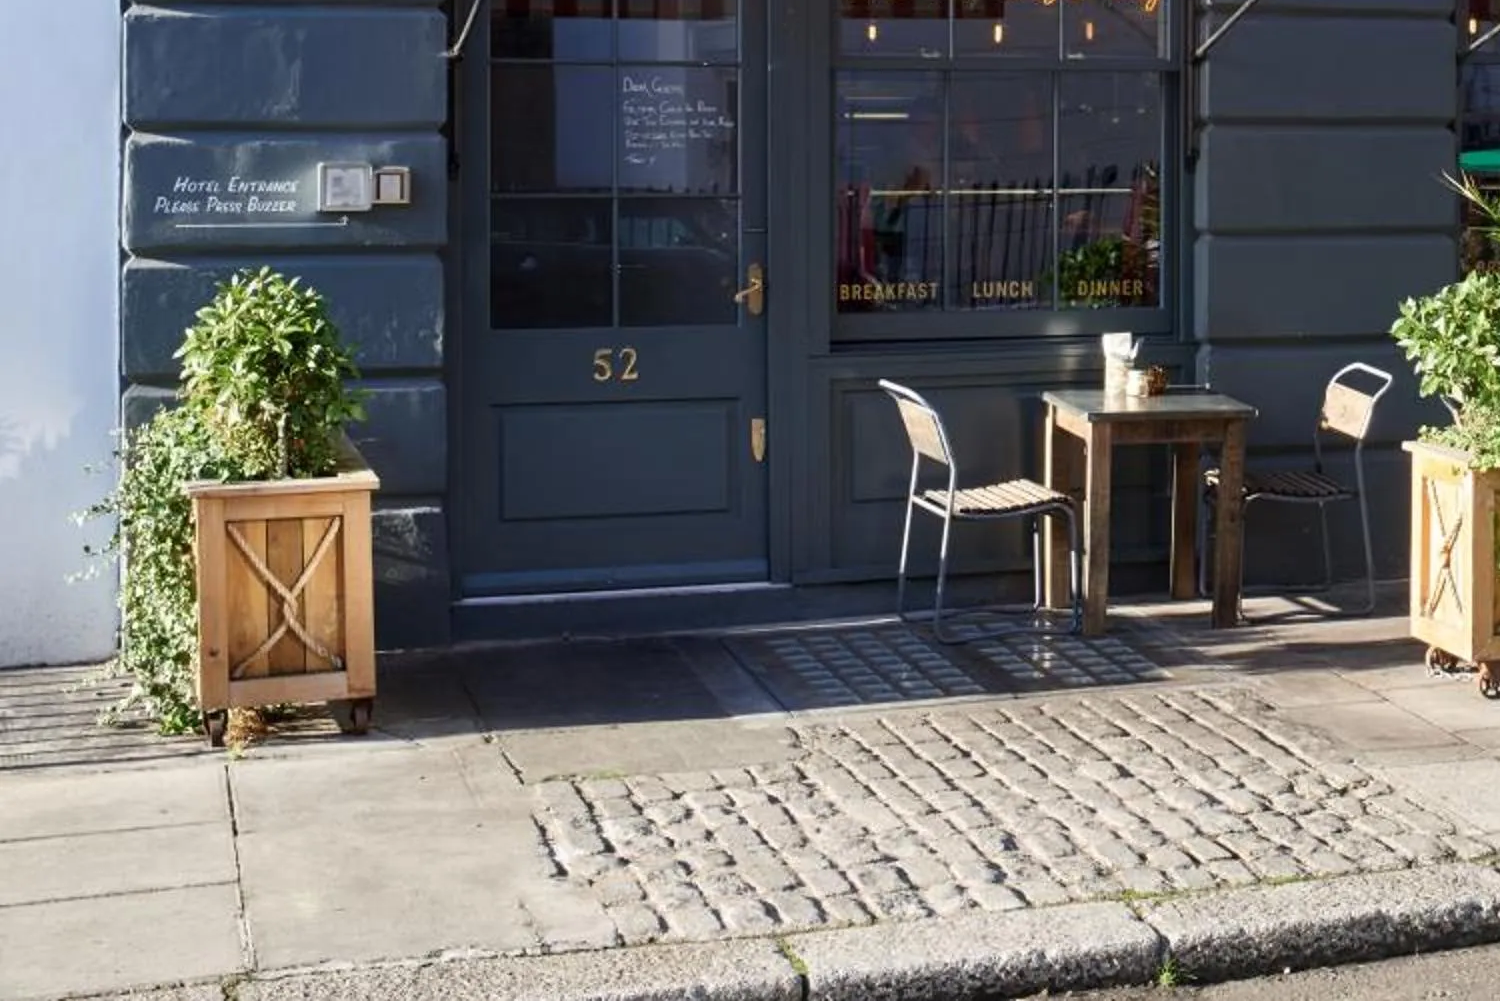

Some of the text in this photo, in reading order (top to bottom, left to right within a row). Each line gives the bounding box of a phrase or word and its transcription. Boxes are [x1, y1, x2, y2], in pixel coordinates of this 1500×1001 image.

[839, 279, 1144, 300] BREAKFAST LUNCH DINNER
[593, 348, 639, 381] 52
